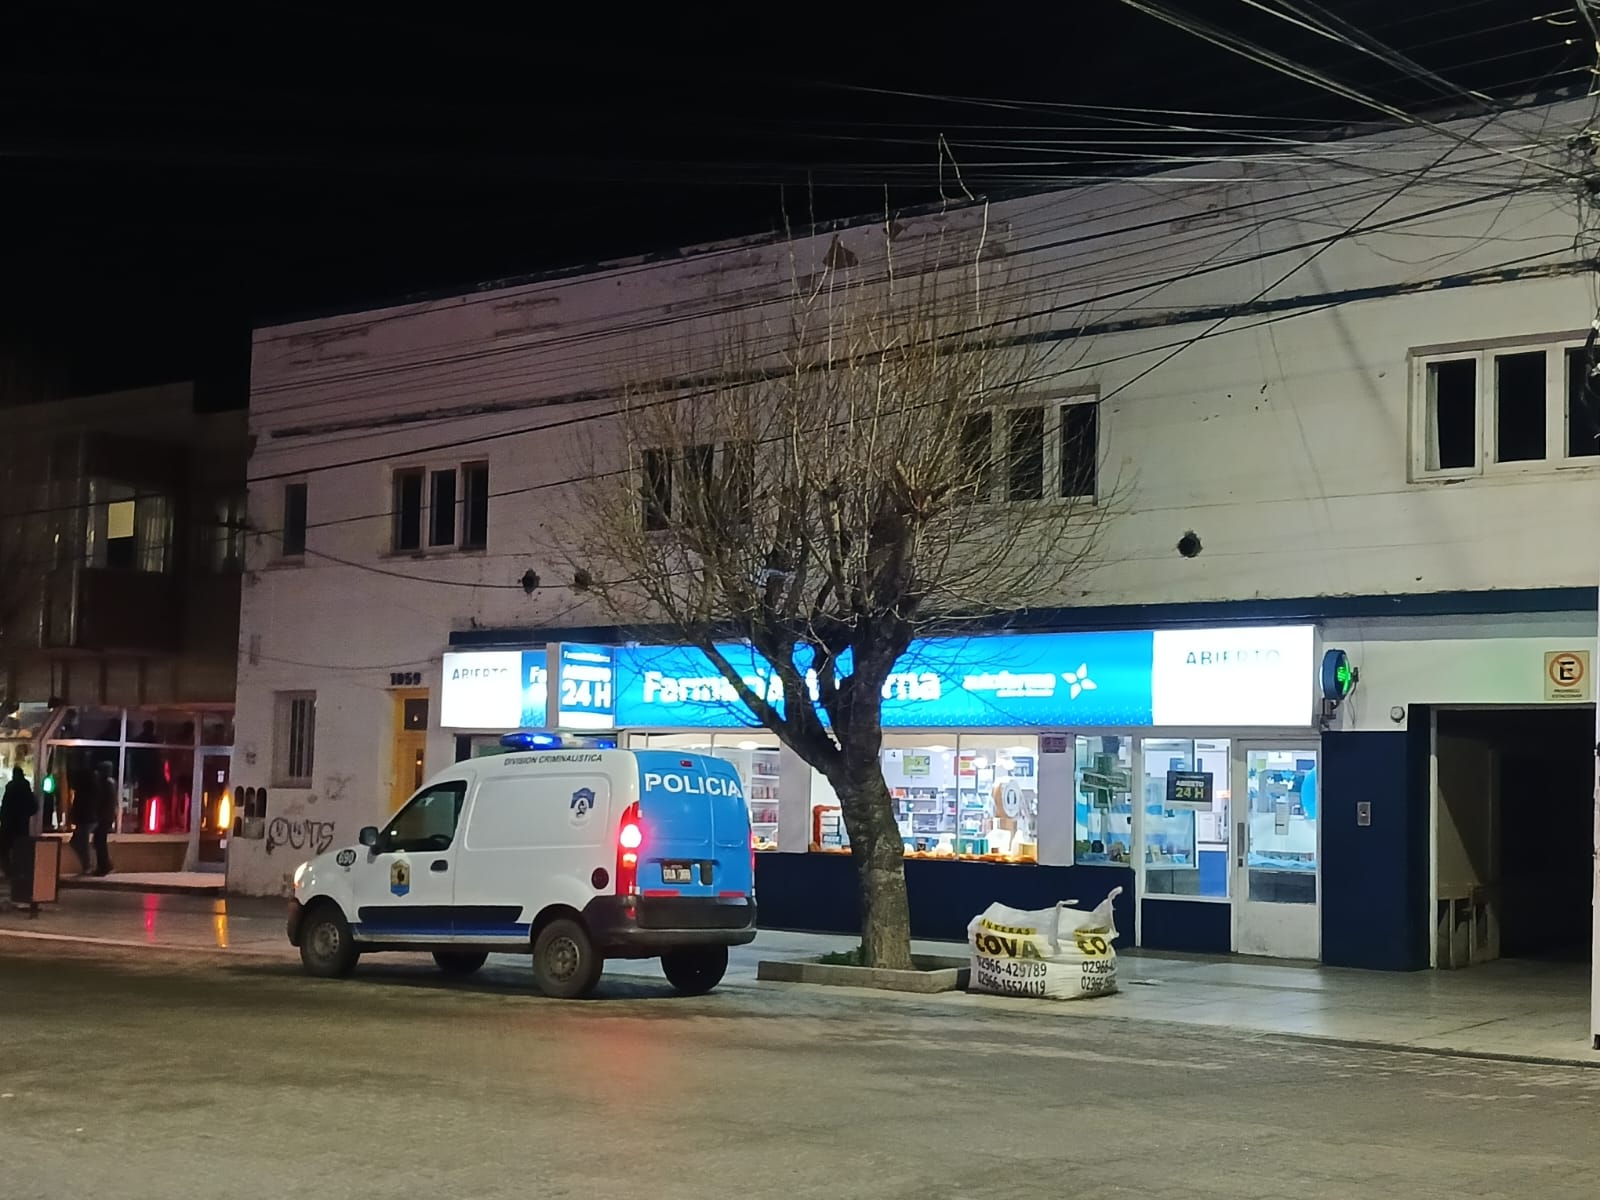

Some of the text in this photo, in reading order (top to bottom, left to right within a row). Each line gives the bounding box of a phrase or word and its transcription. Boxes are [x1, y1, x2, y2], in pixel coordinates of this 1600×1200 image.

[452, 668, 508, 681] ABIER
[562, 679, 592, 707] 24
[594, 681, 612, 708] H
[504, 754, 602, 766] DIVISION CRIMINALISTICA
[645, 773, 743, 798] POLICIA
[1175, 787, 1204, 799] 24 H
[975, 933, 1041, 958] COVA
